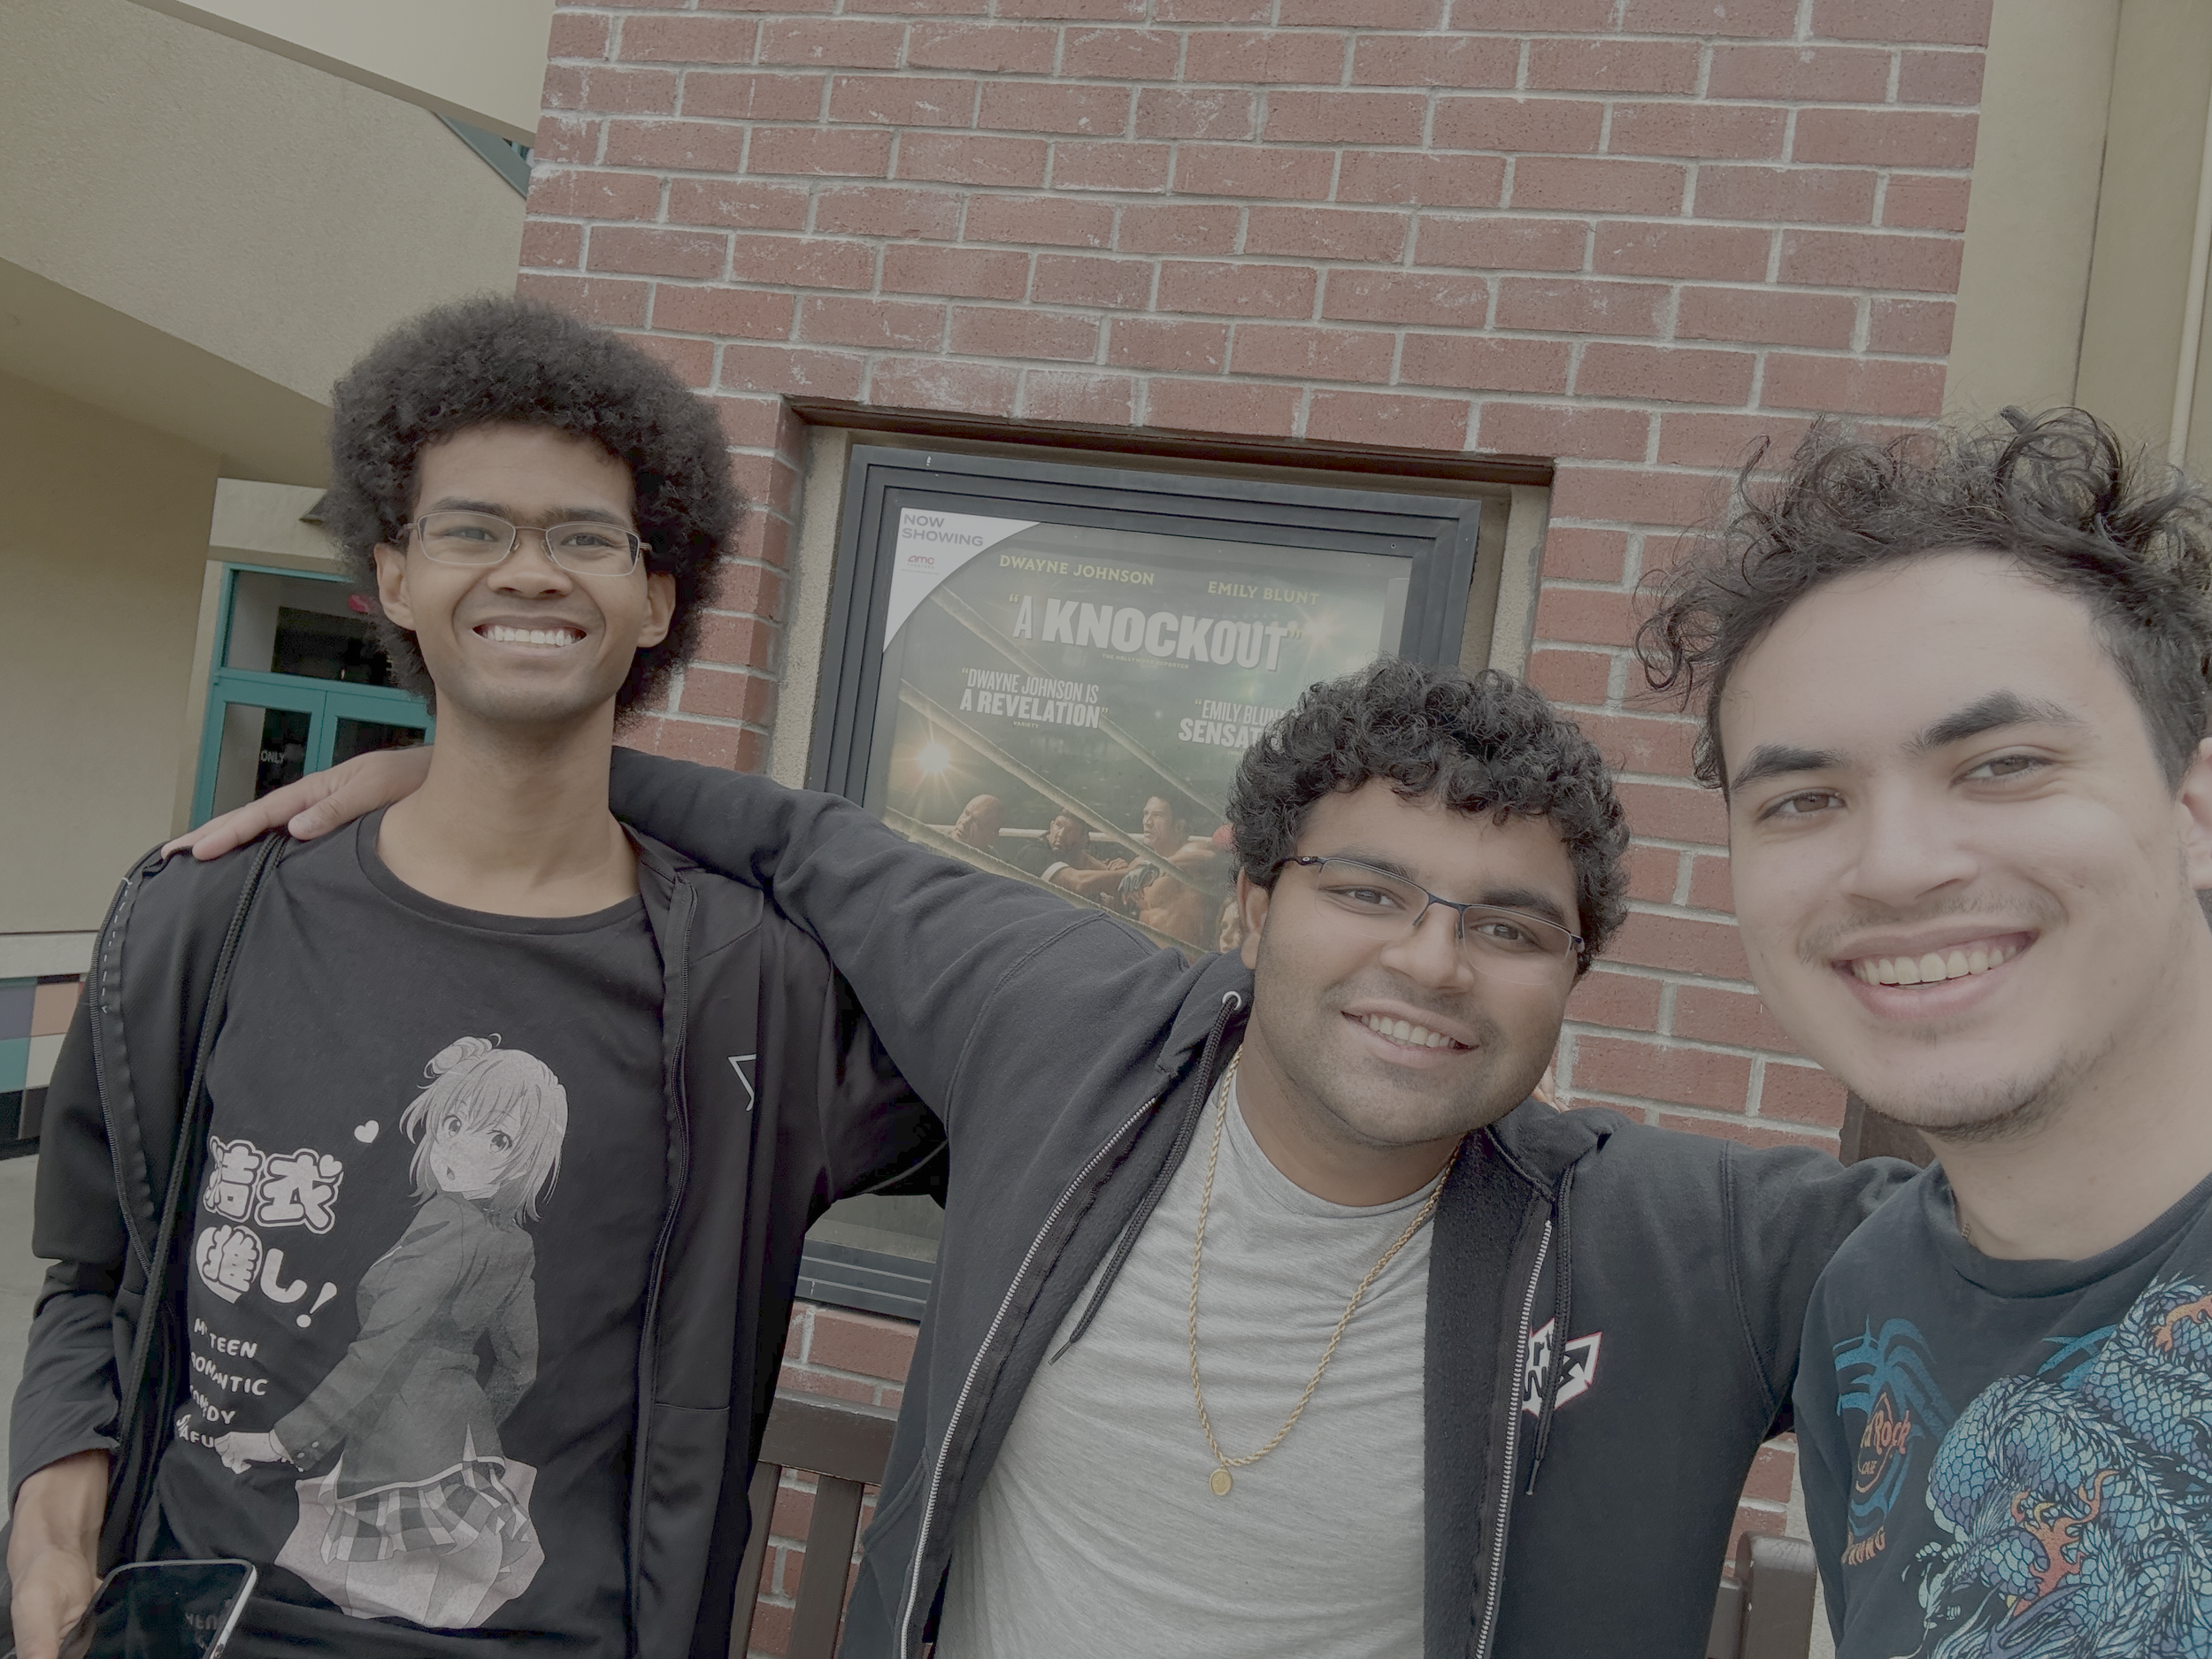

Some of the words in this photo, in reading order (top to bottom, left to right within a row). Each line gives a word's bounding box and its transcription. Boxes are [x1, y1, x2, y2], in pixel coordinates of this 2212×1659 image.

[903, 513, 945, 528] NOW
[902, 527, 984, 547] SHOWING
[907, 555, 935, 565] amc
[999, 554, 1069, 574] DWAYNE
[1073, 564, 1156, 586] JOHNSON
[1207, 580, 1258, 599] EMILY
[1263, 588, 1320, 605] BLUNT
[1115, 656, 1155, 665] HOLLYWOOD
[1155, 660, 1189, 670] REPORTER
[959, 688, 972, 711] A
[1021, 676, 1083, 702] JOHNSON
[1085, 684, 1100, 704] IS
[1013, 720, 1040, 729] VARIETY
[1178, 718, 1265, 749] SENSAT
[260, 749, 284, 764] ONLY
[209, 1333, 257, 1359] TEEN
